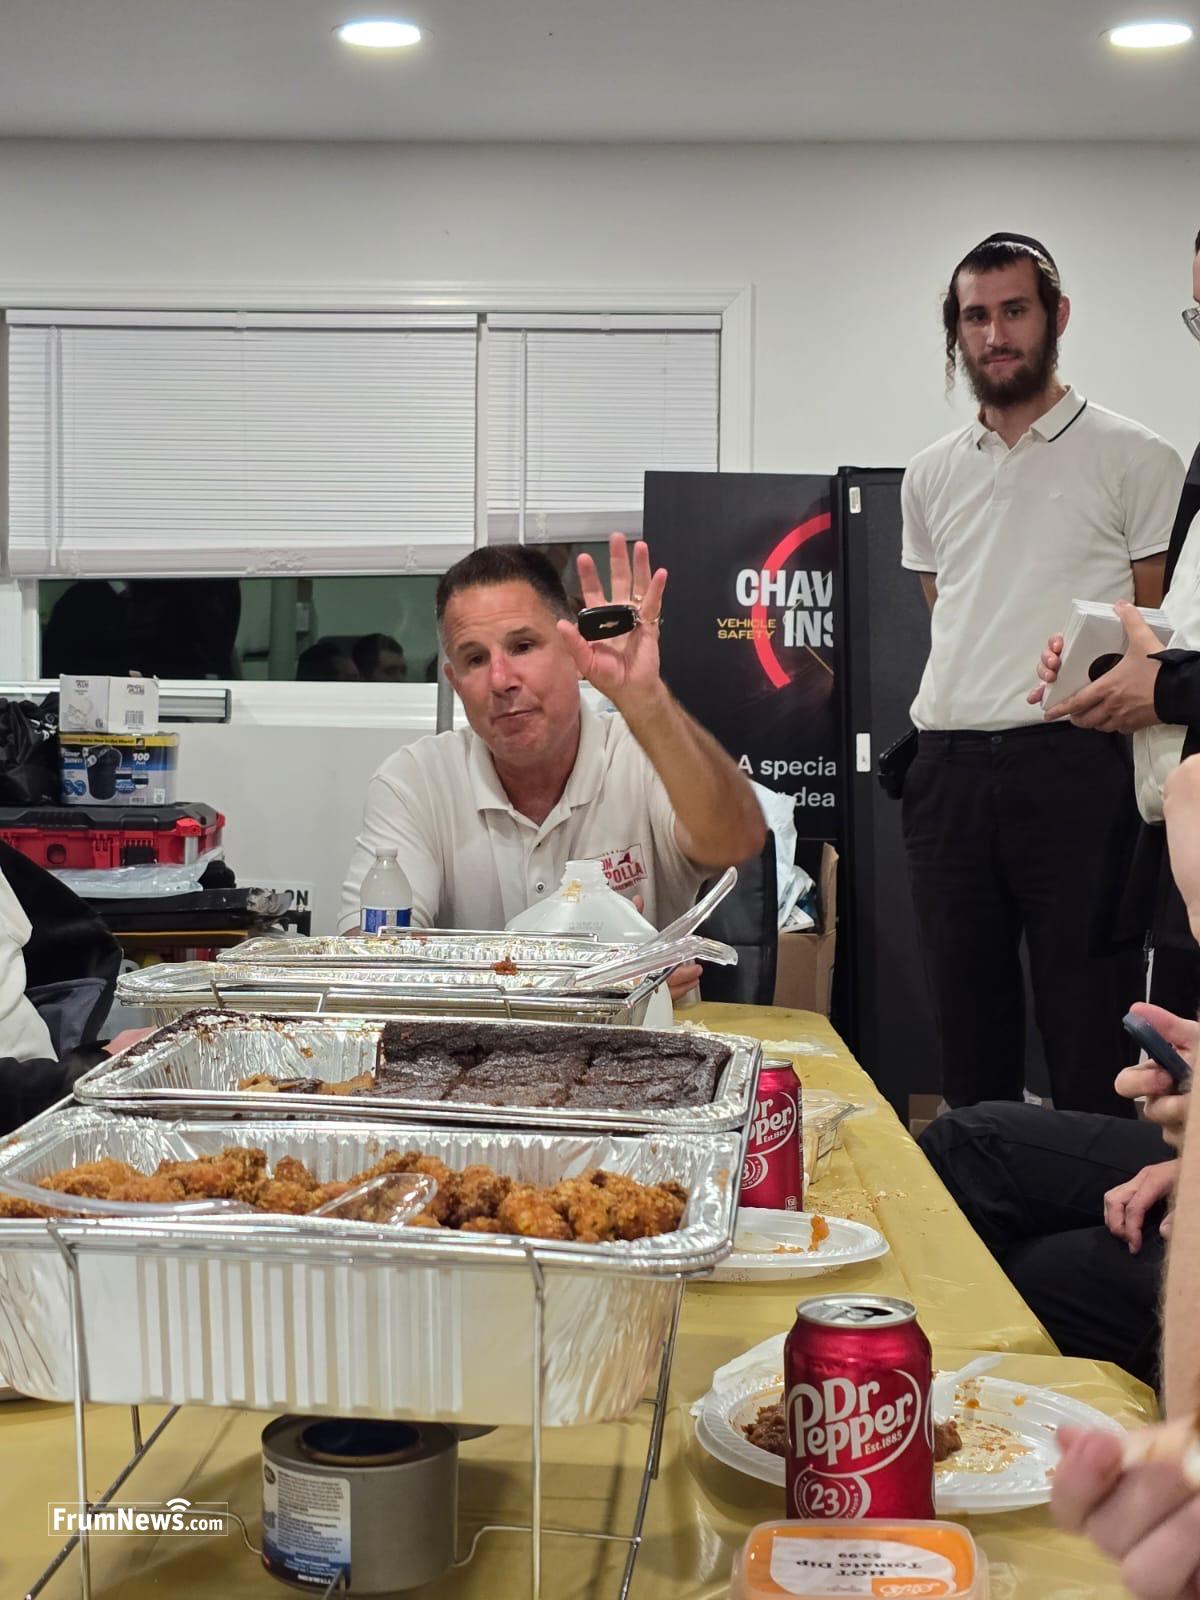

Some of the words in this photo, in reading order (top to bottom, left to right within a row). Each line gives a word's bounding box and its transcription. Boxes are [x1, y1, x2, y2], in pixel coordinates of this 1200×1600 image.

[736, 568, 833, 607] CHAV
[717, 618, 777, 628] VEHICLE
[717, 629, 775, 640] SAFETY
[132, 752, 150, 761] 100
[738, 755, 754, 775] A
[760, 756, 837, 781] specia
[604, 862, 644, 884] POLLA
[822, 1377, 881, 1423] Dr
[787, 1383, 914, 1466] Pepper
[810, 1483, 841, 1516] 23
[796, 1560, 832, 1569] Dip
[840, 1562, 923, 1570] Tomato
